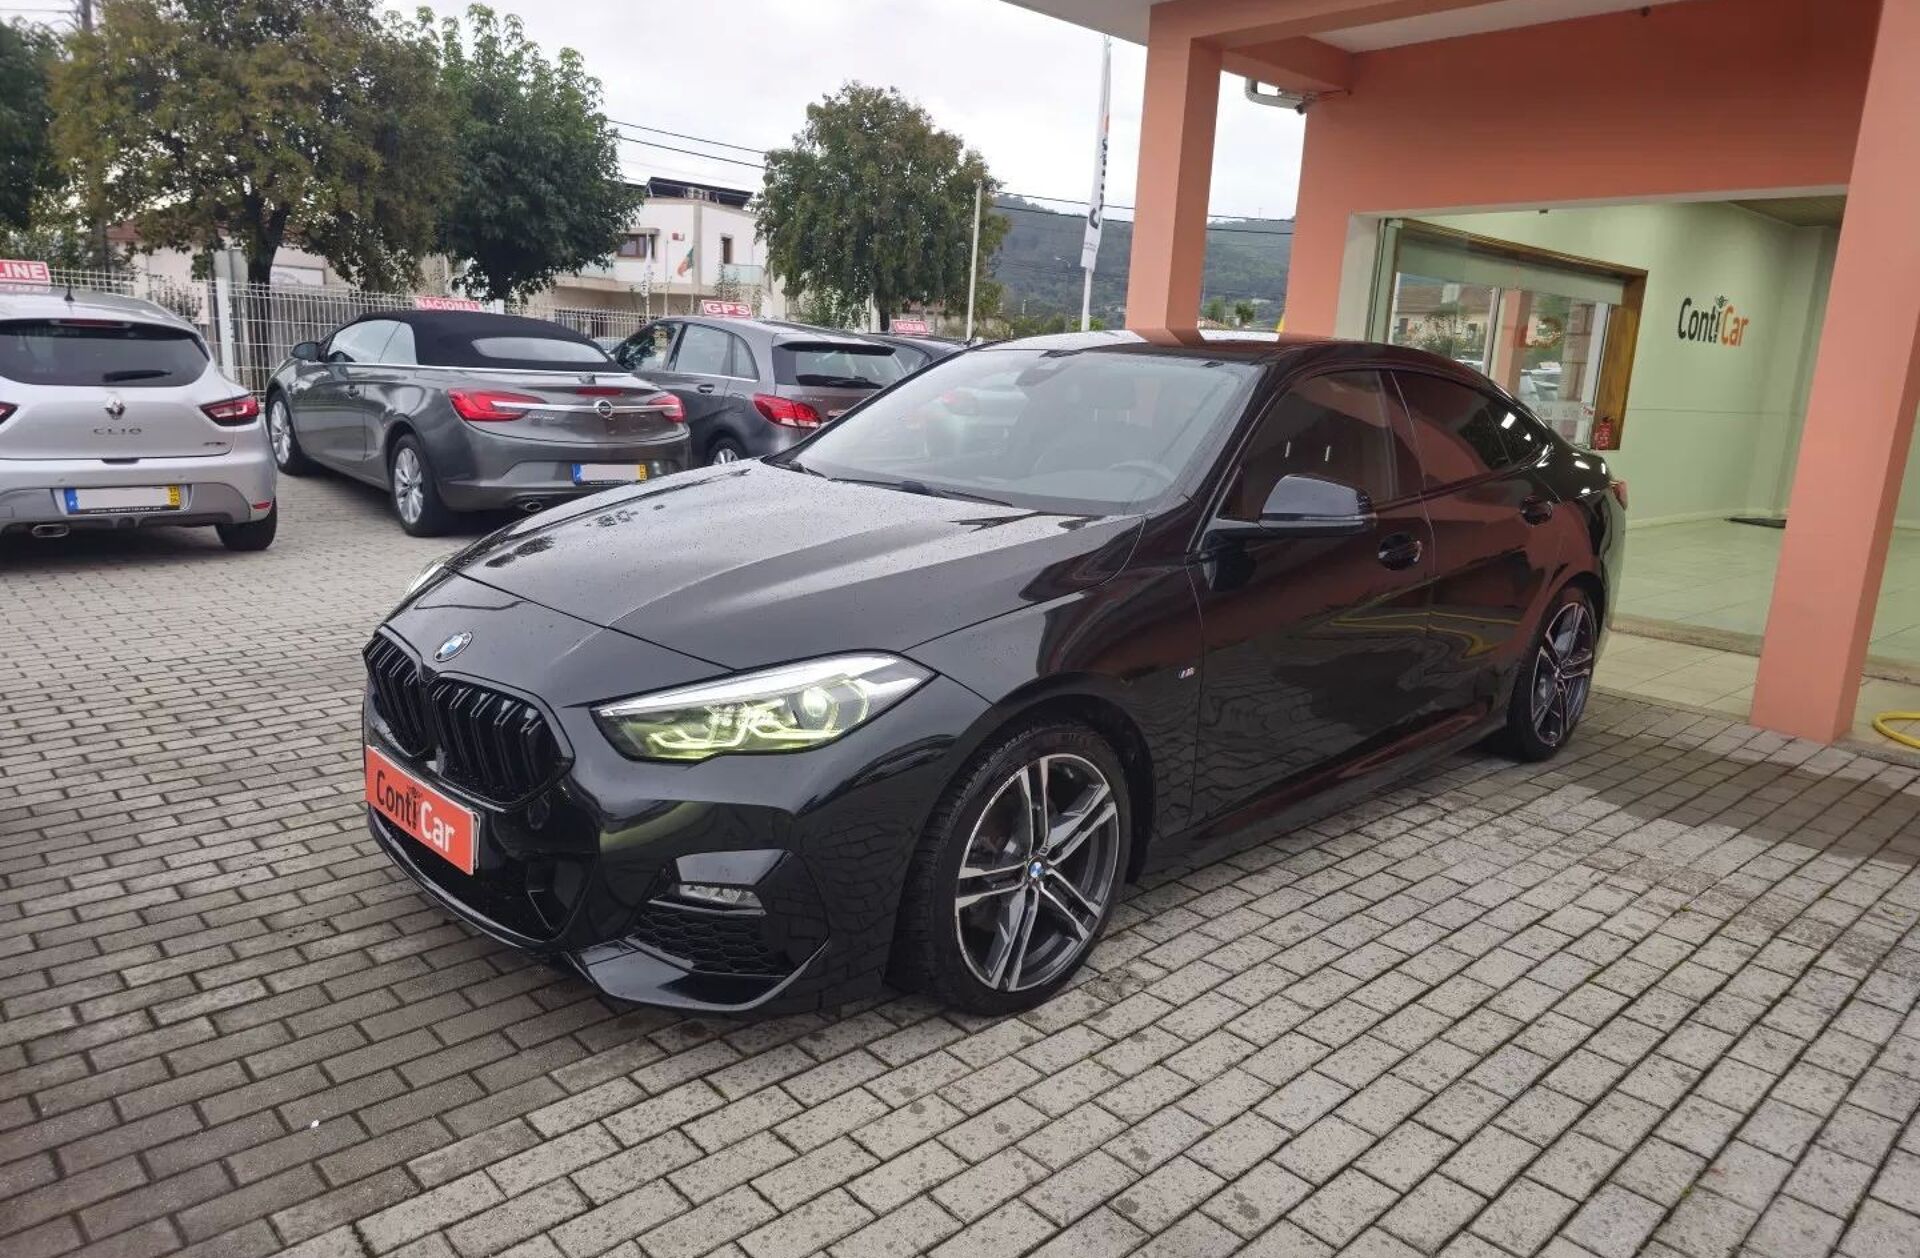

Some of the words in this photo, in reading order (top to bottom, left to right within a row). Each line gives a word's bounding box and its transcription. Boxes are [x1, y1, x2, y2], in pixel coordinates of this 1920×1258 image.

[415, 298, 484, 312] NACIONAL
[704, 303, 750, 315] GPS
[1721, 304, 1749, 347] Car
[376, 769, 418, 830] Conti
[420, 800, 455, 853] Car
